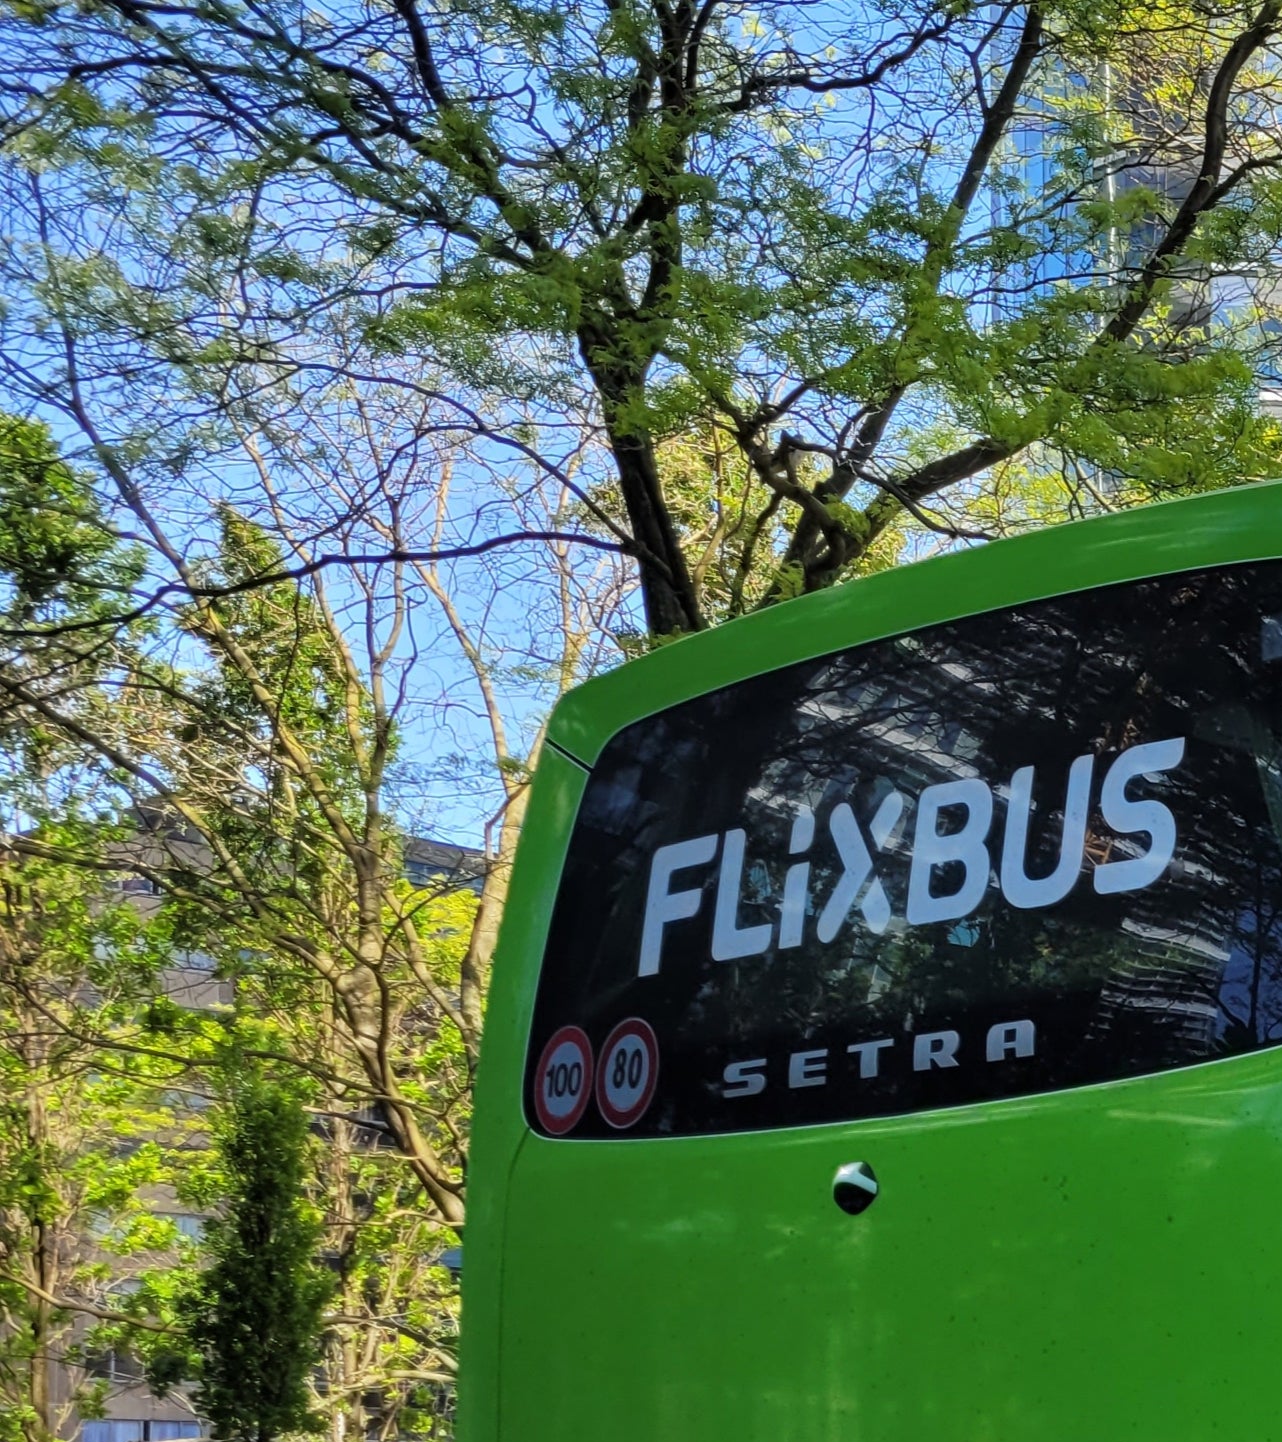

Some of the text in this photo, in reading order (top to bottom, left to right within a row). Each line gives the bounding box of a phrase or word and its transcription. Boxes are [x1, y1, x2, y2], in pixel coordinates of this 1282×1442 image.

[612, 1048, 643, 1089] 80
[722, 1019, 1037, 1098] SETRA
[546, 1062, 582, 1098] 100
